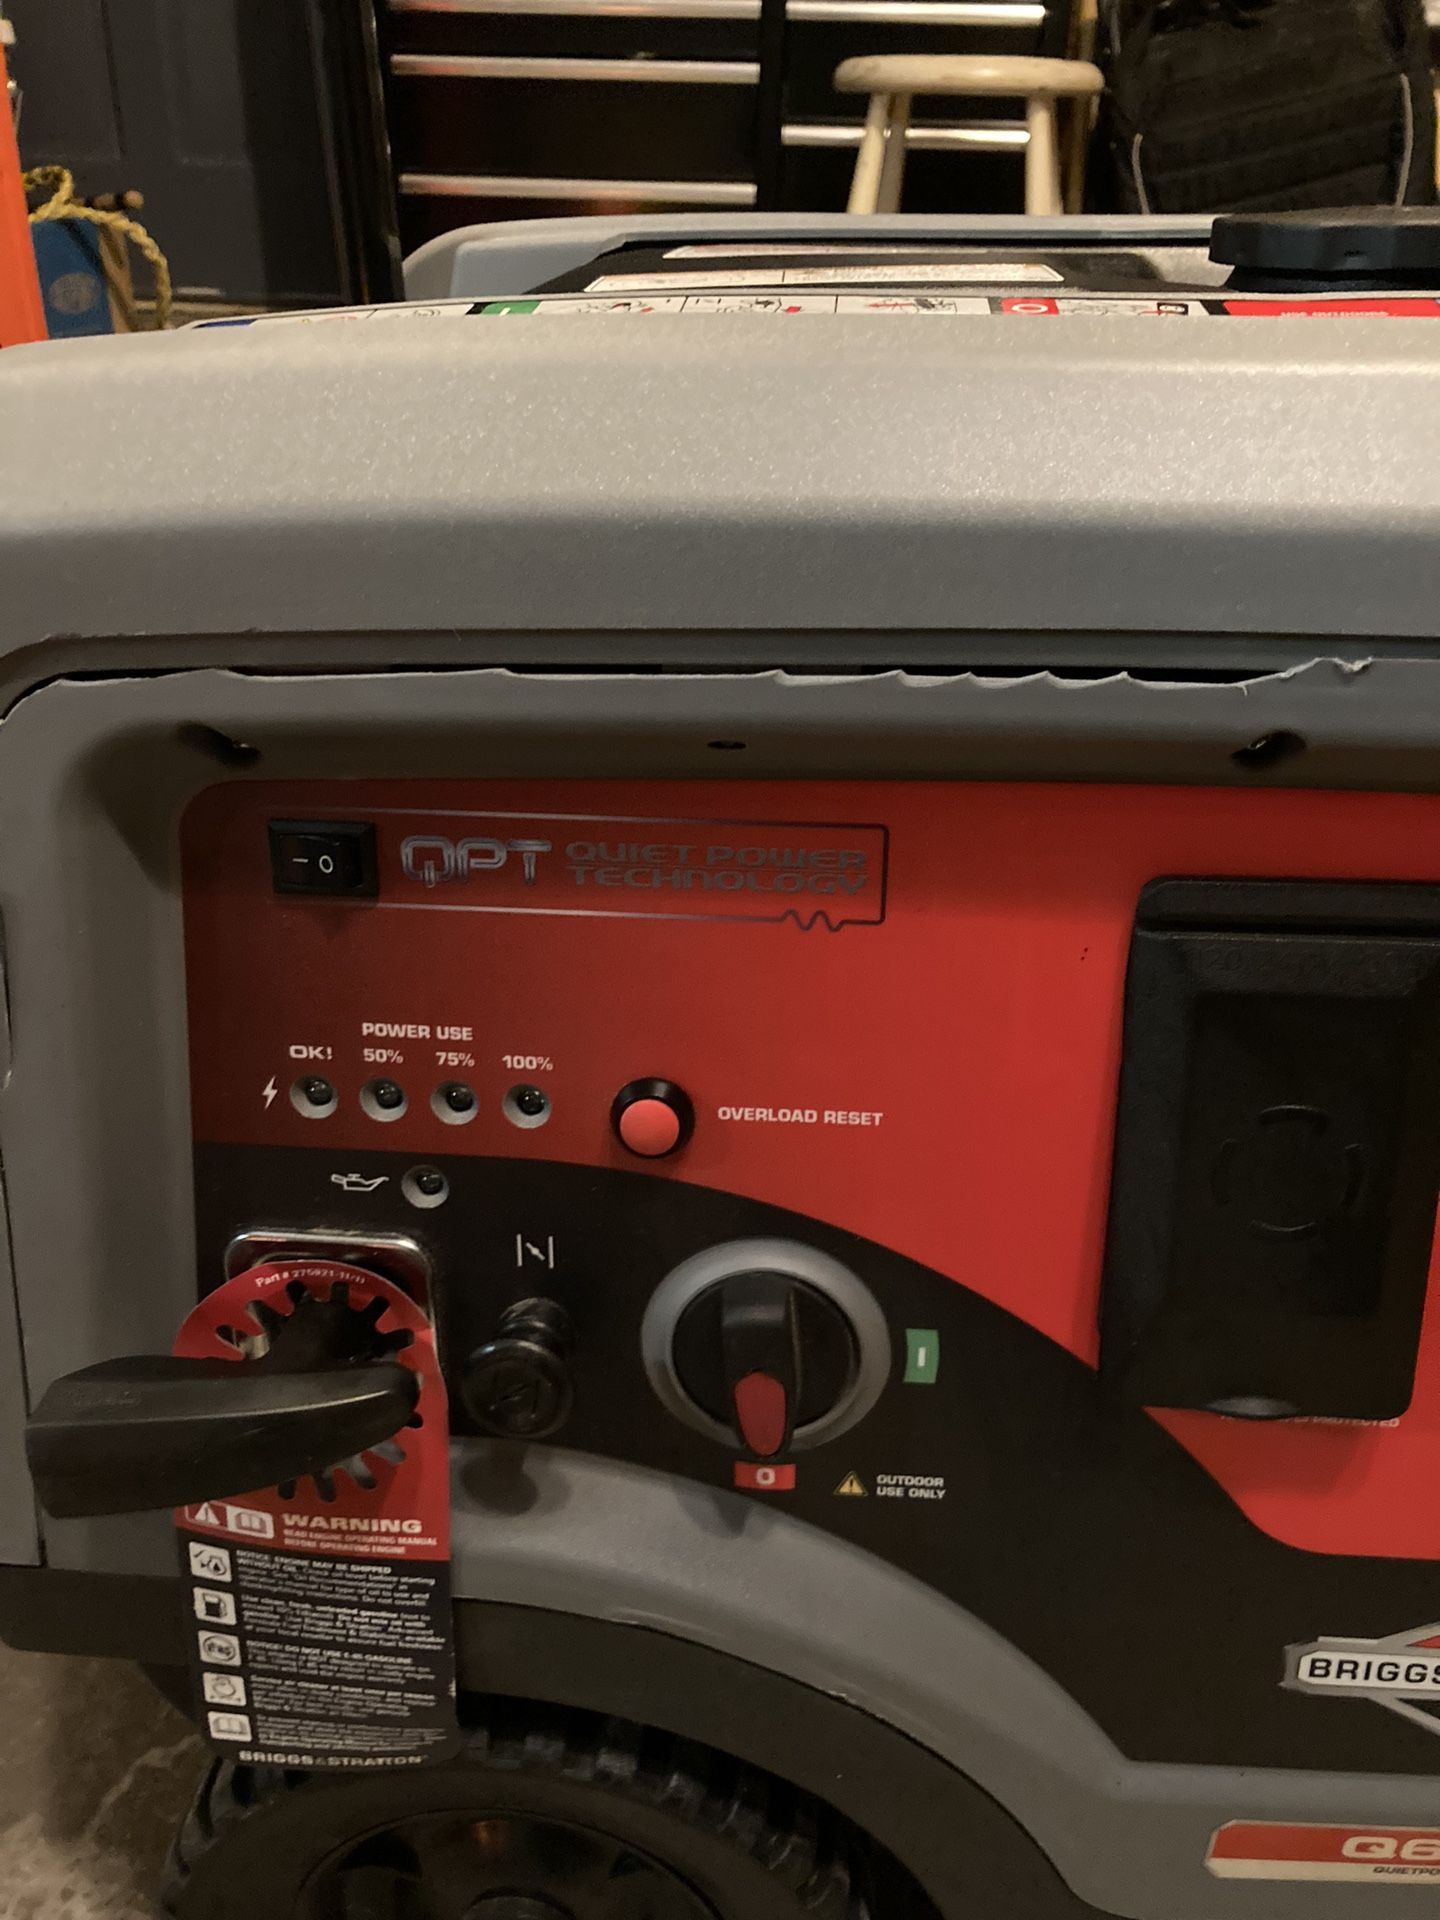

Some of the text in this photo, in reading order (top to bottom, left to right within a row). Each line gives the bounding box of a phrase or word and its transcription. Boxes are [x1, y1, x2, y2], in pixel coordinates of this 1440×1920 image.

[400, 835, 552, 888] QPT
[564, 842, 867, 869] QUIET POWER
[564, 864, 868, 895] TECHNOLOGY
[361, 1022, 473, 1041] POWER USE
[289, 1044, 333, 1060] OK!
[363, 1048, 403, 1064] 50%
[435, 1051, 475, 1067] 75%
[502, 1054, 553, 1071] 100%
[717, 1106, 884, 1126] OVERLOAD RESET
[876, 1474, 945, 1488] OUTDOOR
[876, 1486, 947, 1500] USE ONLY
[282, 1513, 422, 1534] WARNING
